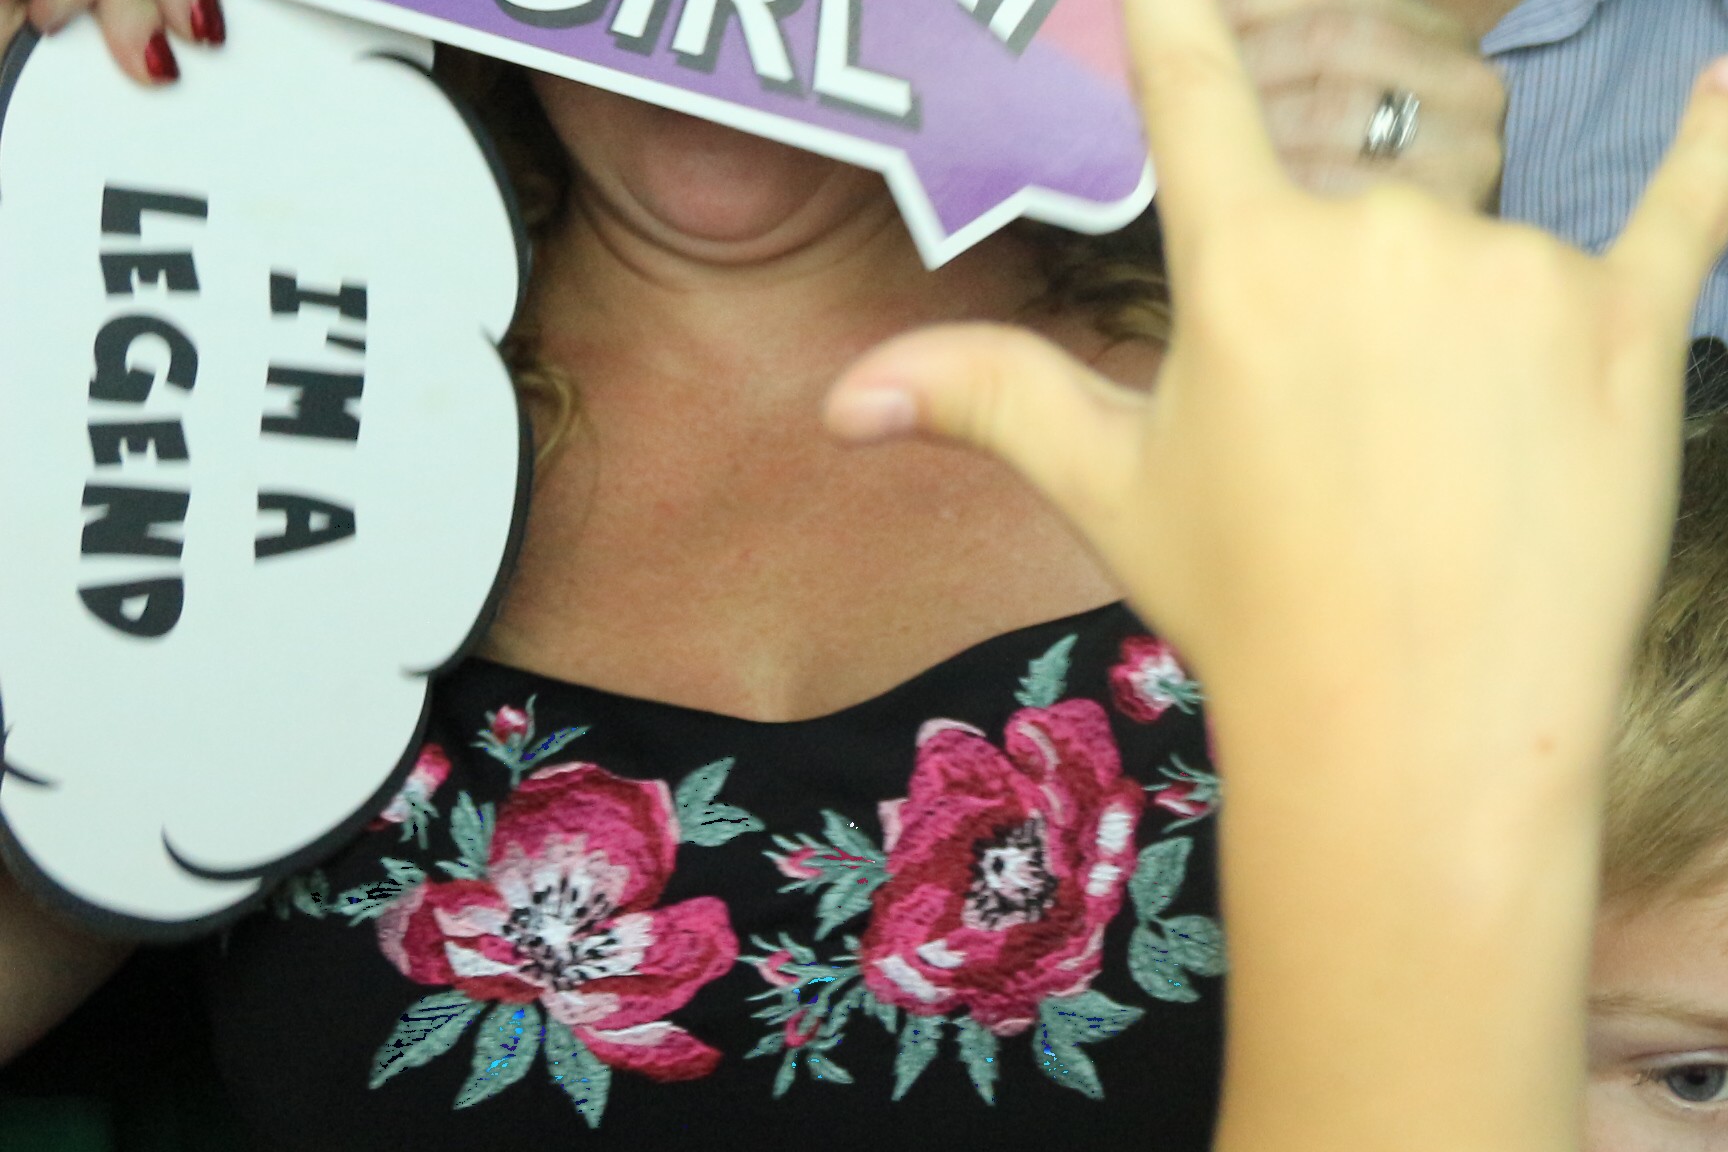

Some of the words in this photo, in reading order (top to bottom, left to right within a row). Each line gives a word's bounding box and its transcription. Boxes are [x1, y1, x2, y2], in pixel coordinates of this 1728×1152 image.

[77, 181, 208, 638] LEGEND
[260, 269, 368, 445] I'M
[254, 486, 357, 563] A
